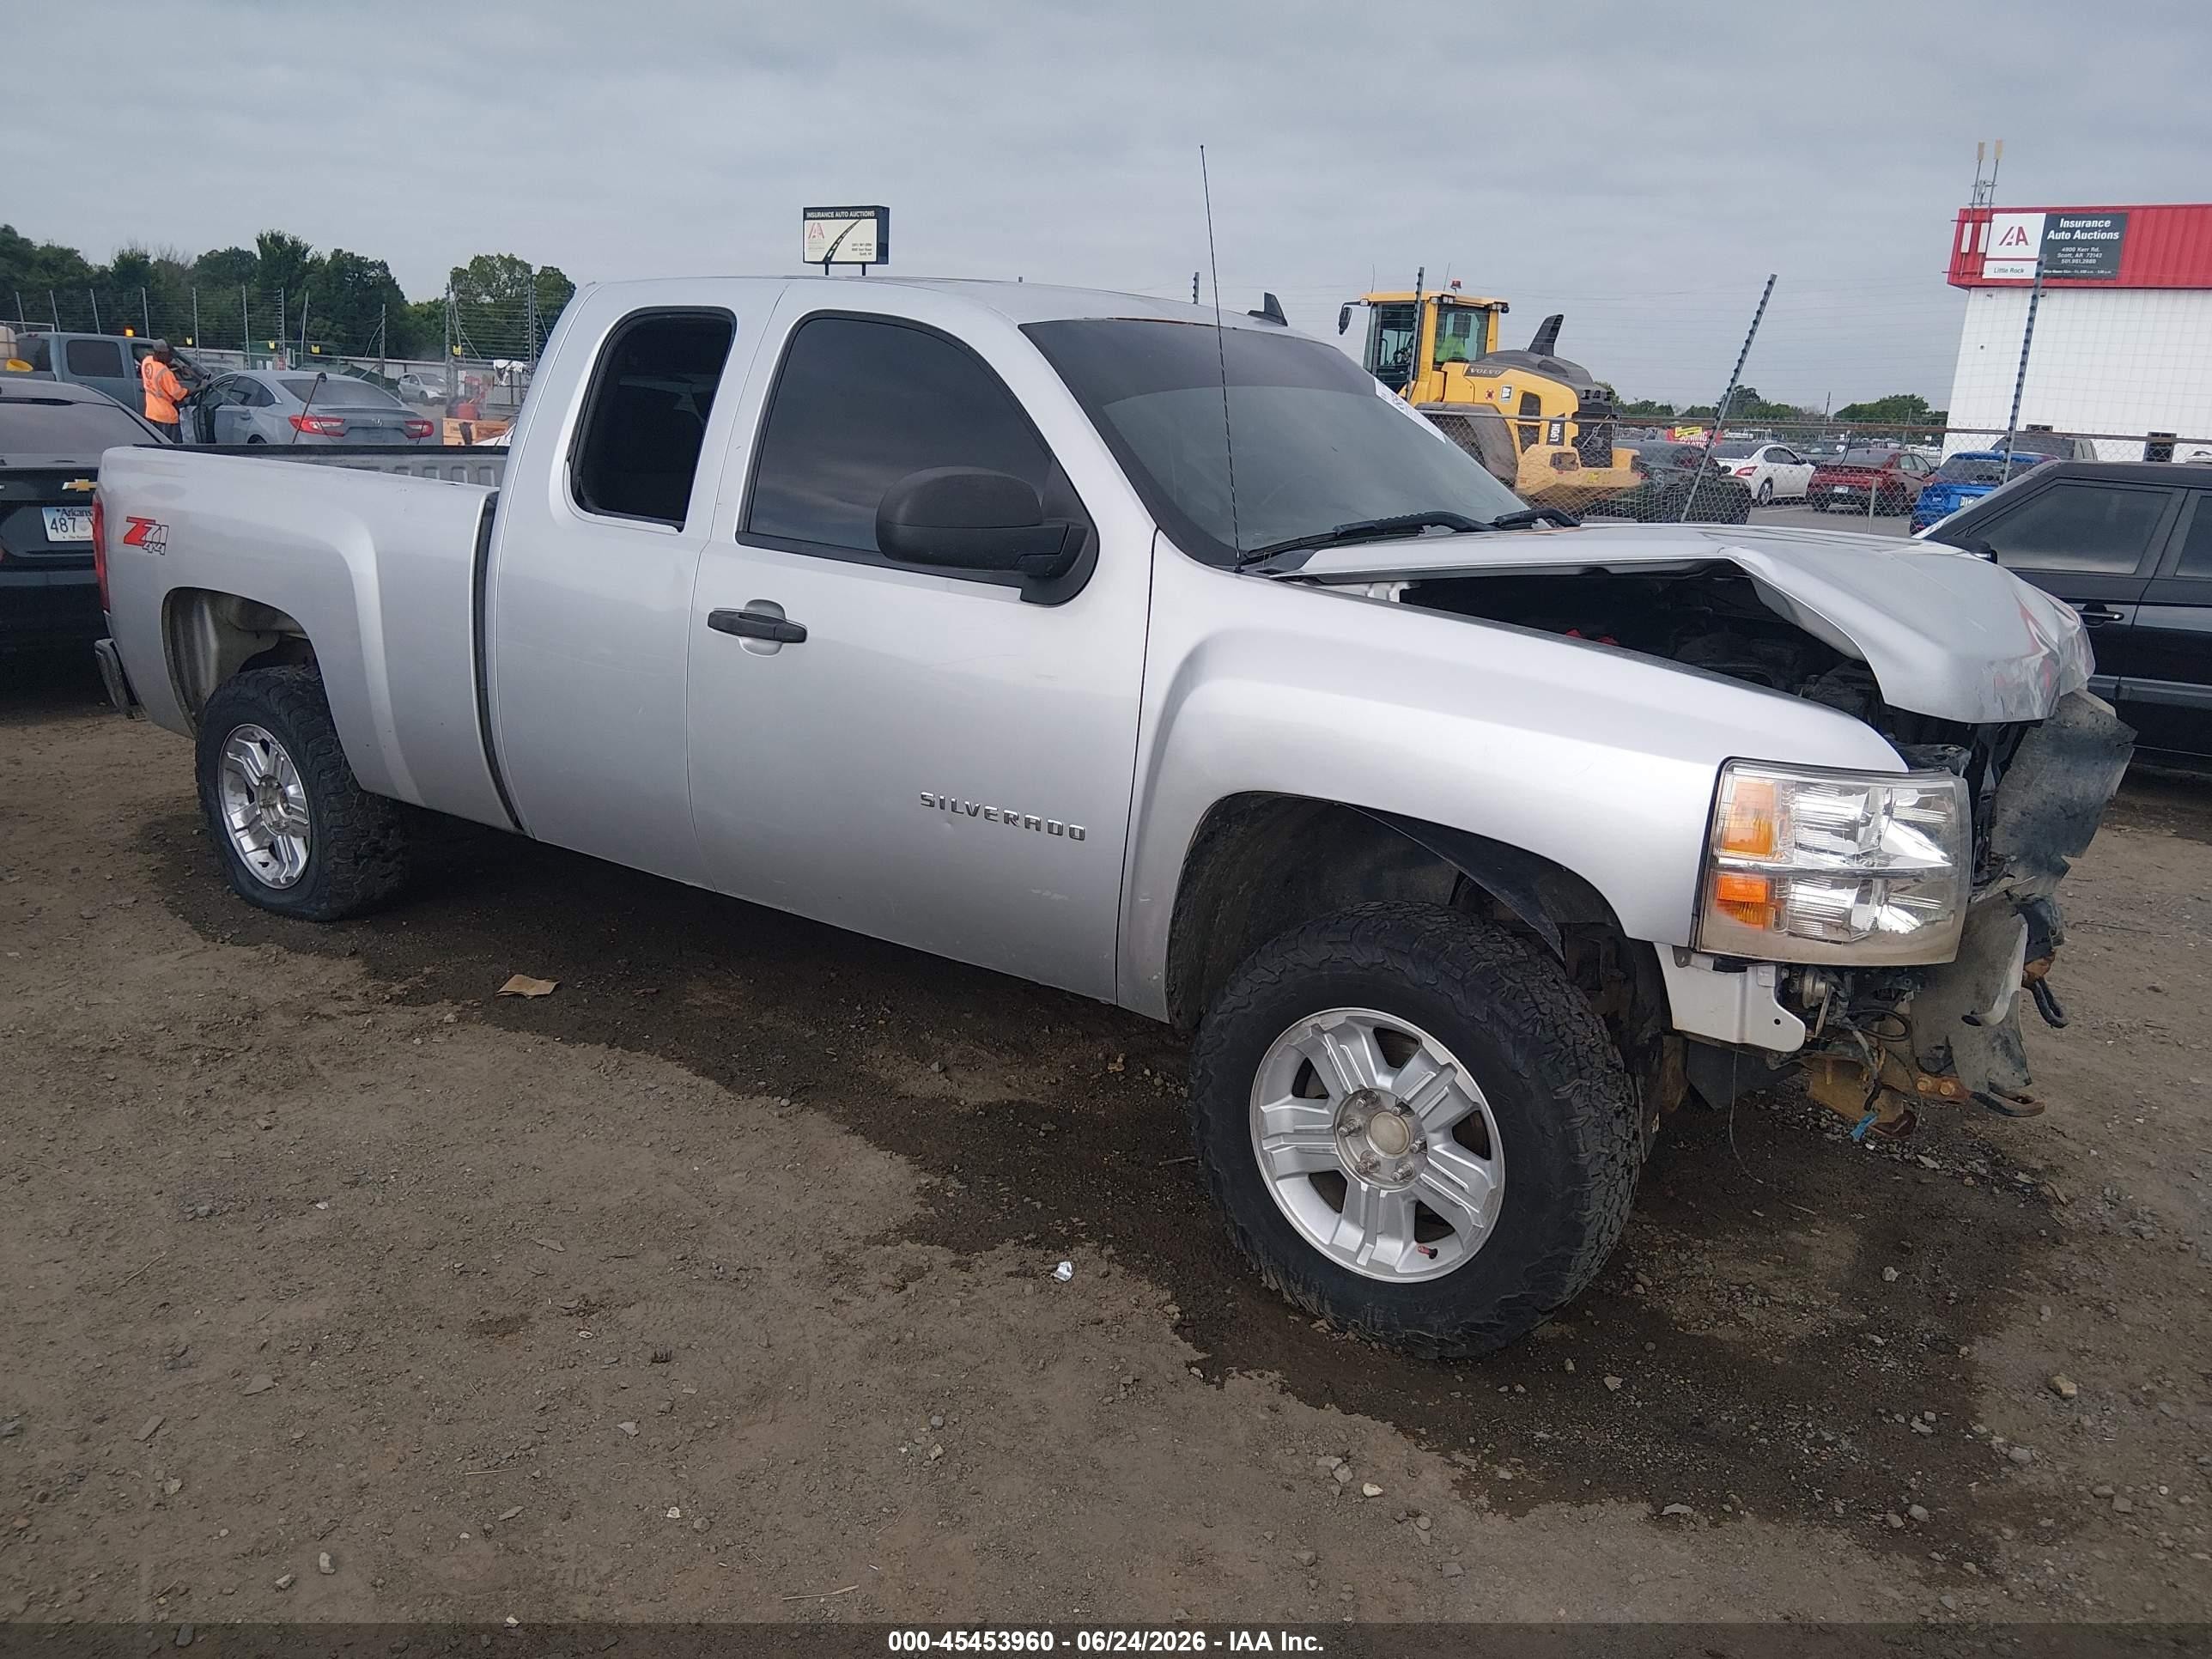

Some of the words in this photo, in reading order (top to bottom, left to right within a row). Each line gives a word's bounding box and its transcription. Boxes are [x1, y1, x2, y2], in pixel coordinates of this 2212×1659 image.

[2060, 218, 2112, 228] Insurance
[2047, 230, 2071, 240] Auto
[2073, 229, 2119, 240] Auctions
[51, 517, 76, 533] 487
[124, 516, 169, 546] Z71
[920, 791, 1085, 841] SILVERADO
